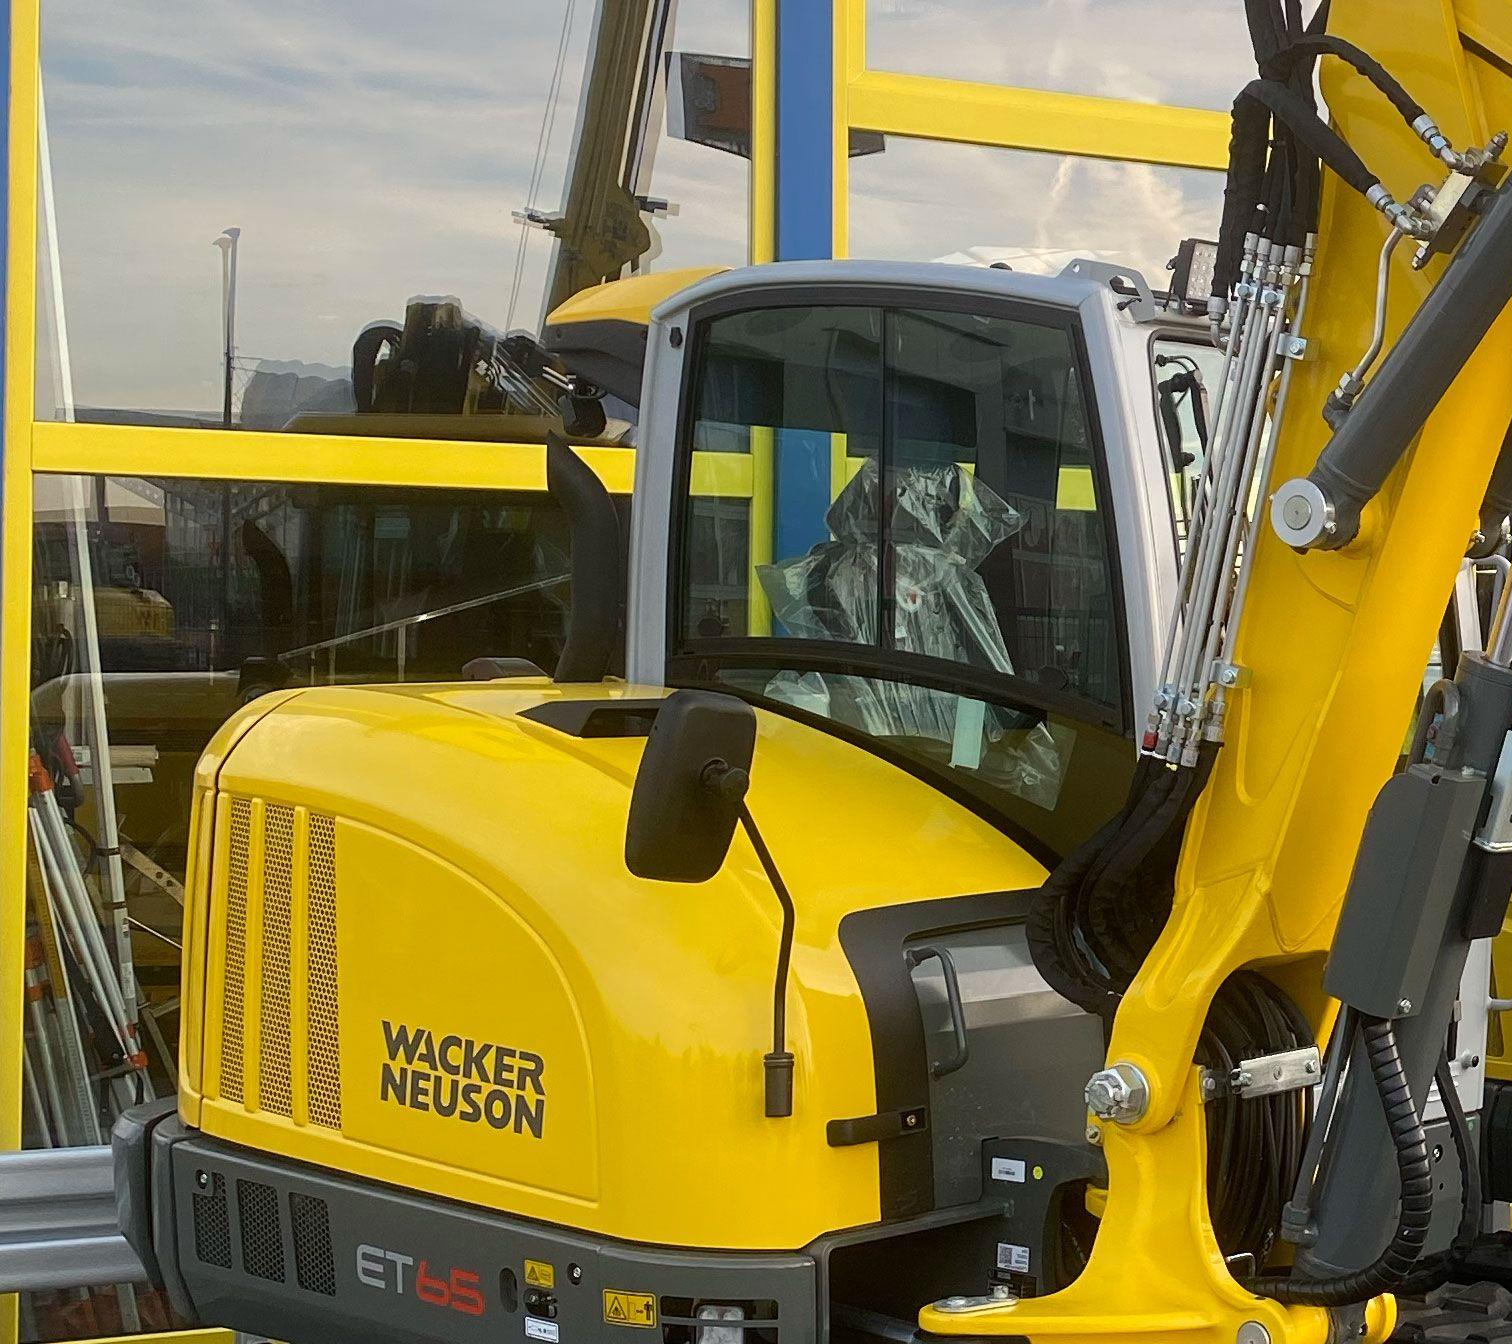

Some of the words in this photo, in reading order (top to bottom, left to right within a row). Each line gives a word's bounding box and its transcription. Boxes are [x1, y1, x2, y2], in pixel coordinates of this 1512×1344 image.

[381, 1019, 546, 1096] WACKER
[380, 1063, 545, 1139] NEUSON
[356, 1243, 486, 1316] ET65
